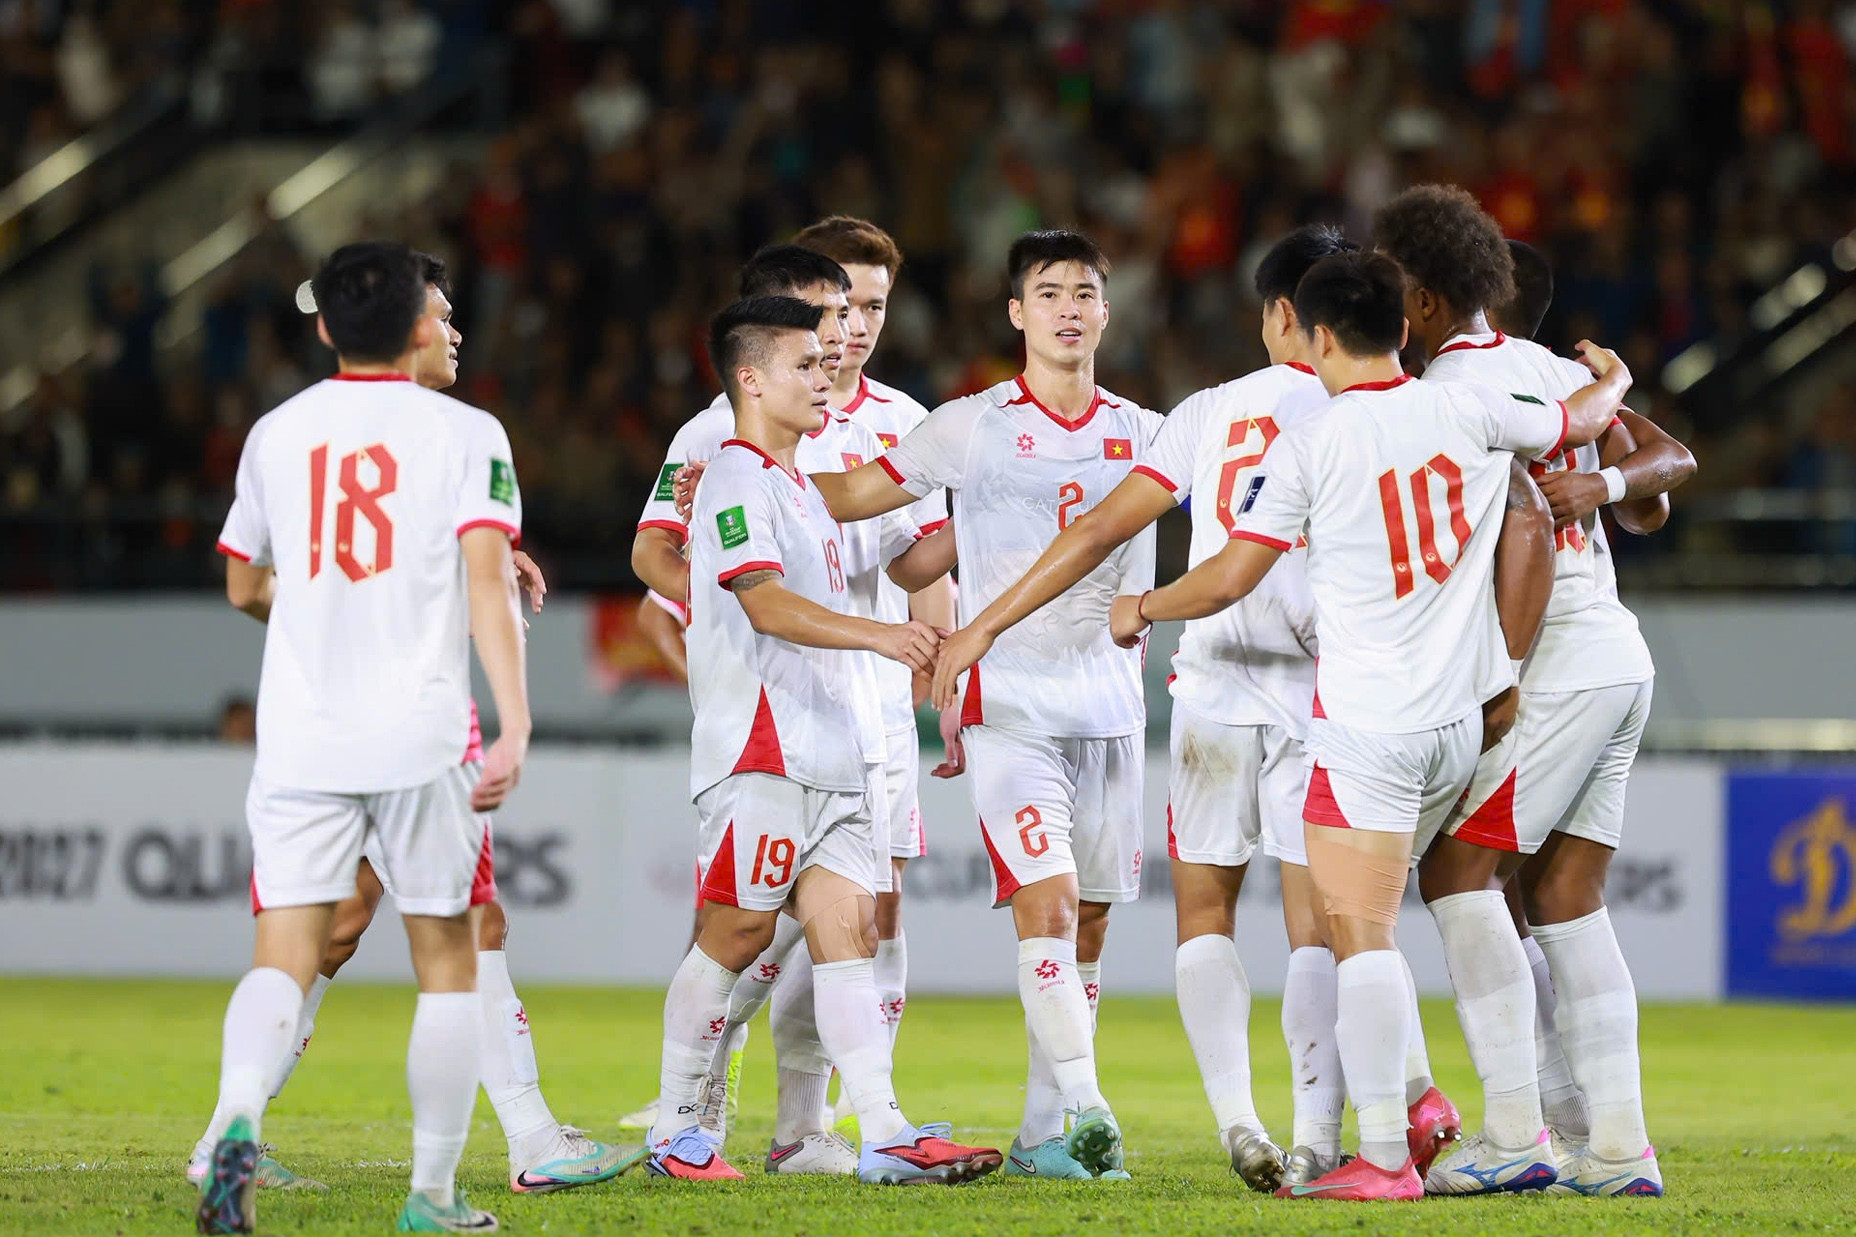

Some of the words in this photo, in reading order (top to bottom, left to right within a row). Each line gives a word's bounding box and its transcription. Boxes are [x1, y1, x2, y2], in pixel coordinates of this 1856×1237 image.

[308, 441, 398, 584] 18
[1058, 481, 1084, 532] 2
[1377, 453, 1473, 600] 10
[821, 538, 844, 593] 19
[1014, 804, 1050, 859] 2
[749, 833, 797, 889] 19
